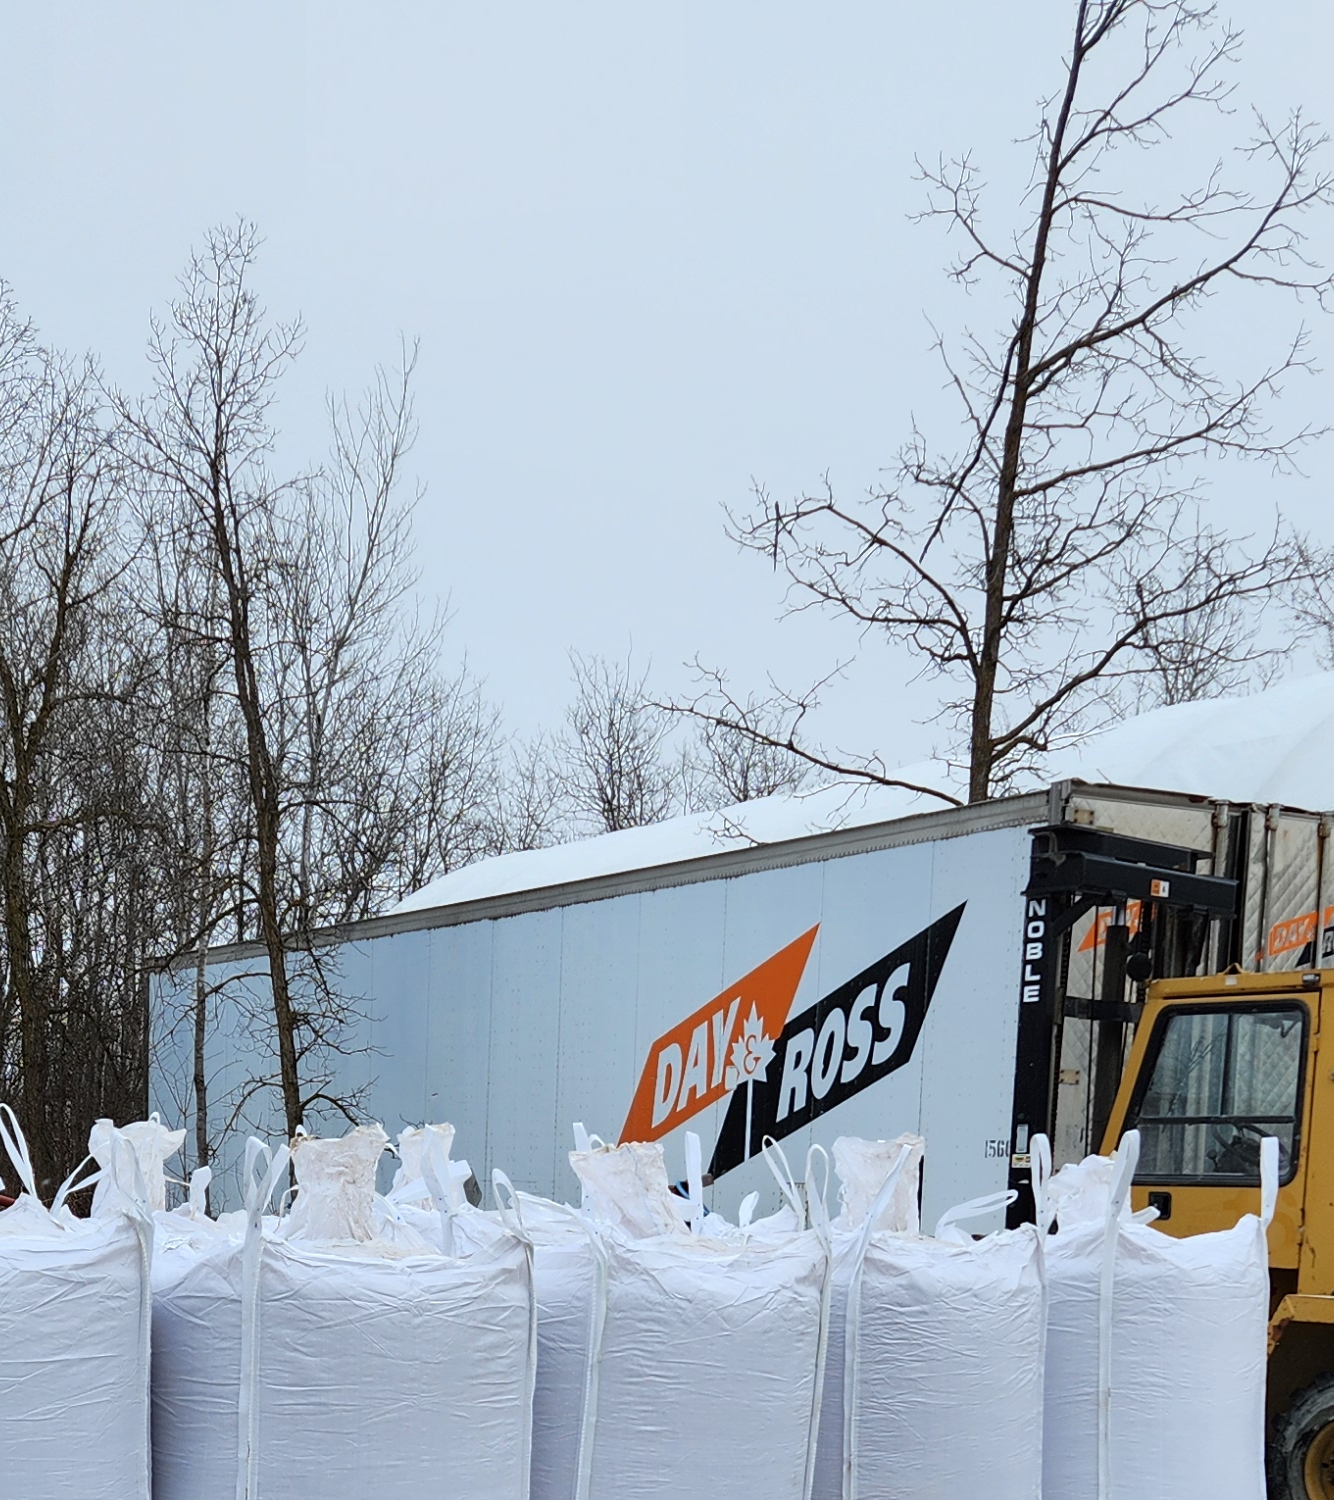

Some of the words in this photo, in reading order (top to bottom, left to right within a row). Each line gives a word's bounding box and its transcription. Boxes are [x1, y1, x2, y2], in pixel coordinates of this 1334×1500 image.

[1023, 899, 1046, 1003] NOBLE
[1274, 918, 1310, 950] DAY
[651, 996, 742, 1129] DAY
[743, 1034, 761, 1075] &
[775, 962, 911, 1124] ROSS
